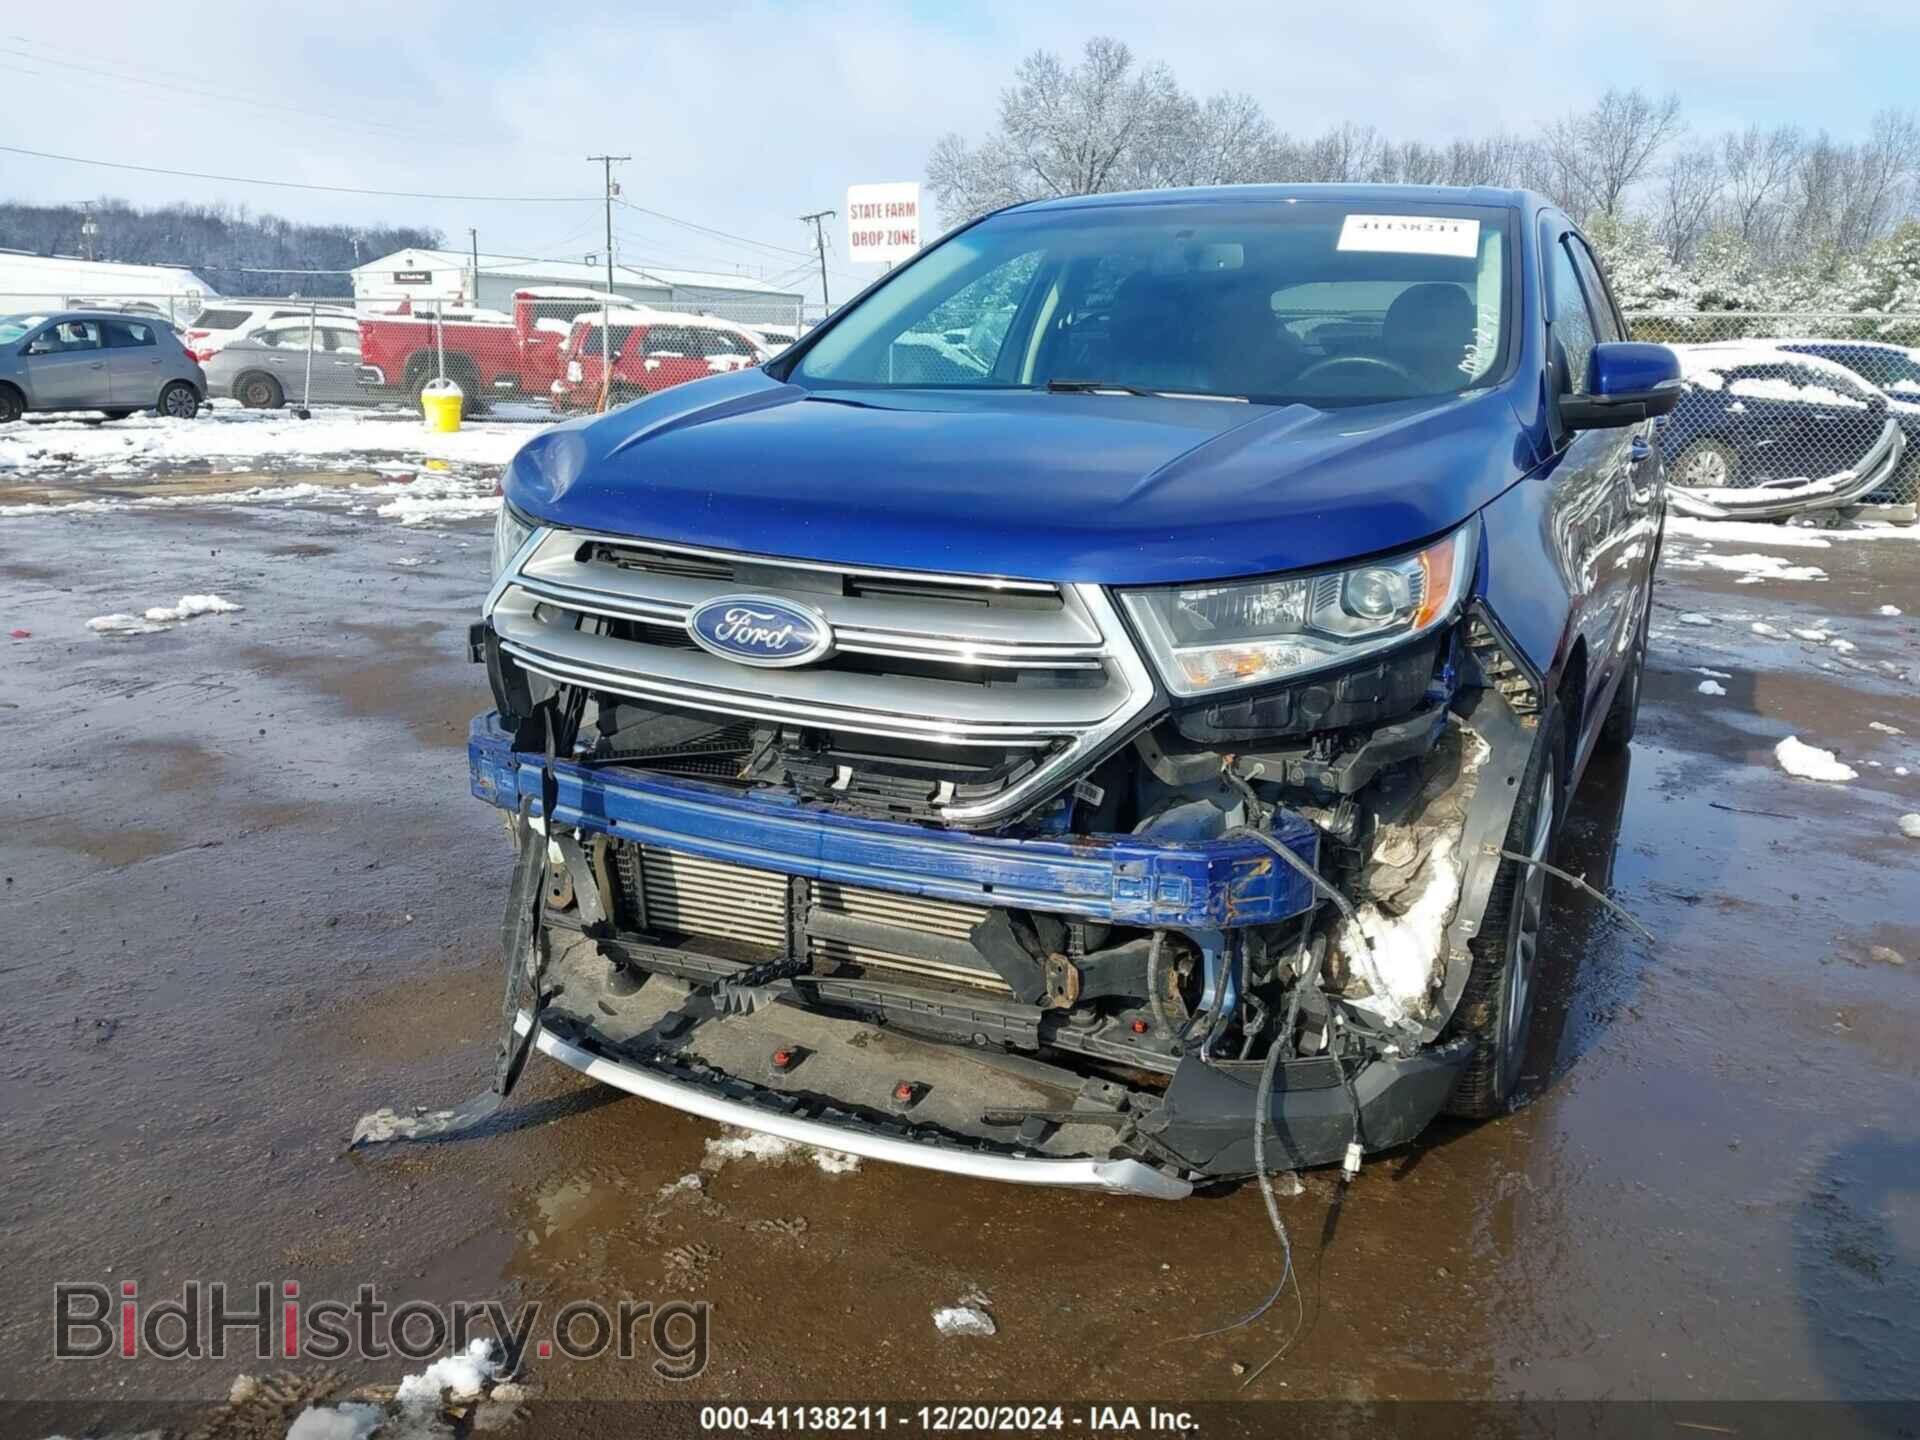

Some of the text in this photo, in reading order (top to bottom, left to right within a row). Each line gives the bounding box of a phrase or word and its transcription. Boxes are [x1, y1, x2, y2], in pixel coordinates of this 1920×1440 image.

[850, 202, 916, 219] STATE FARM
[852, 229, 917, 247] DROP ZONE
[715, 608, 793, 649] Ford
